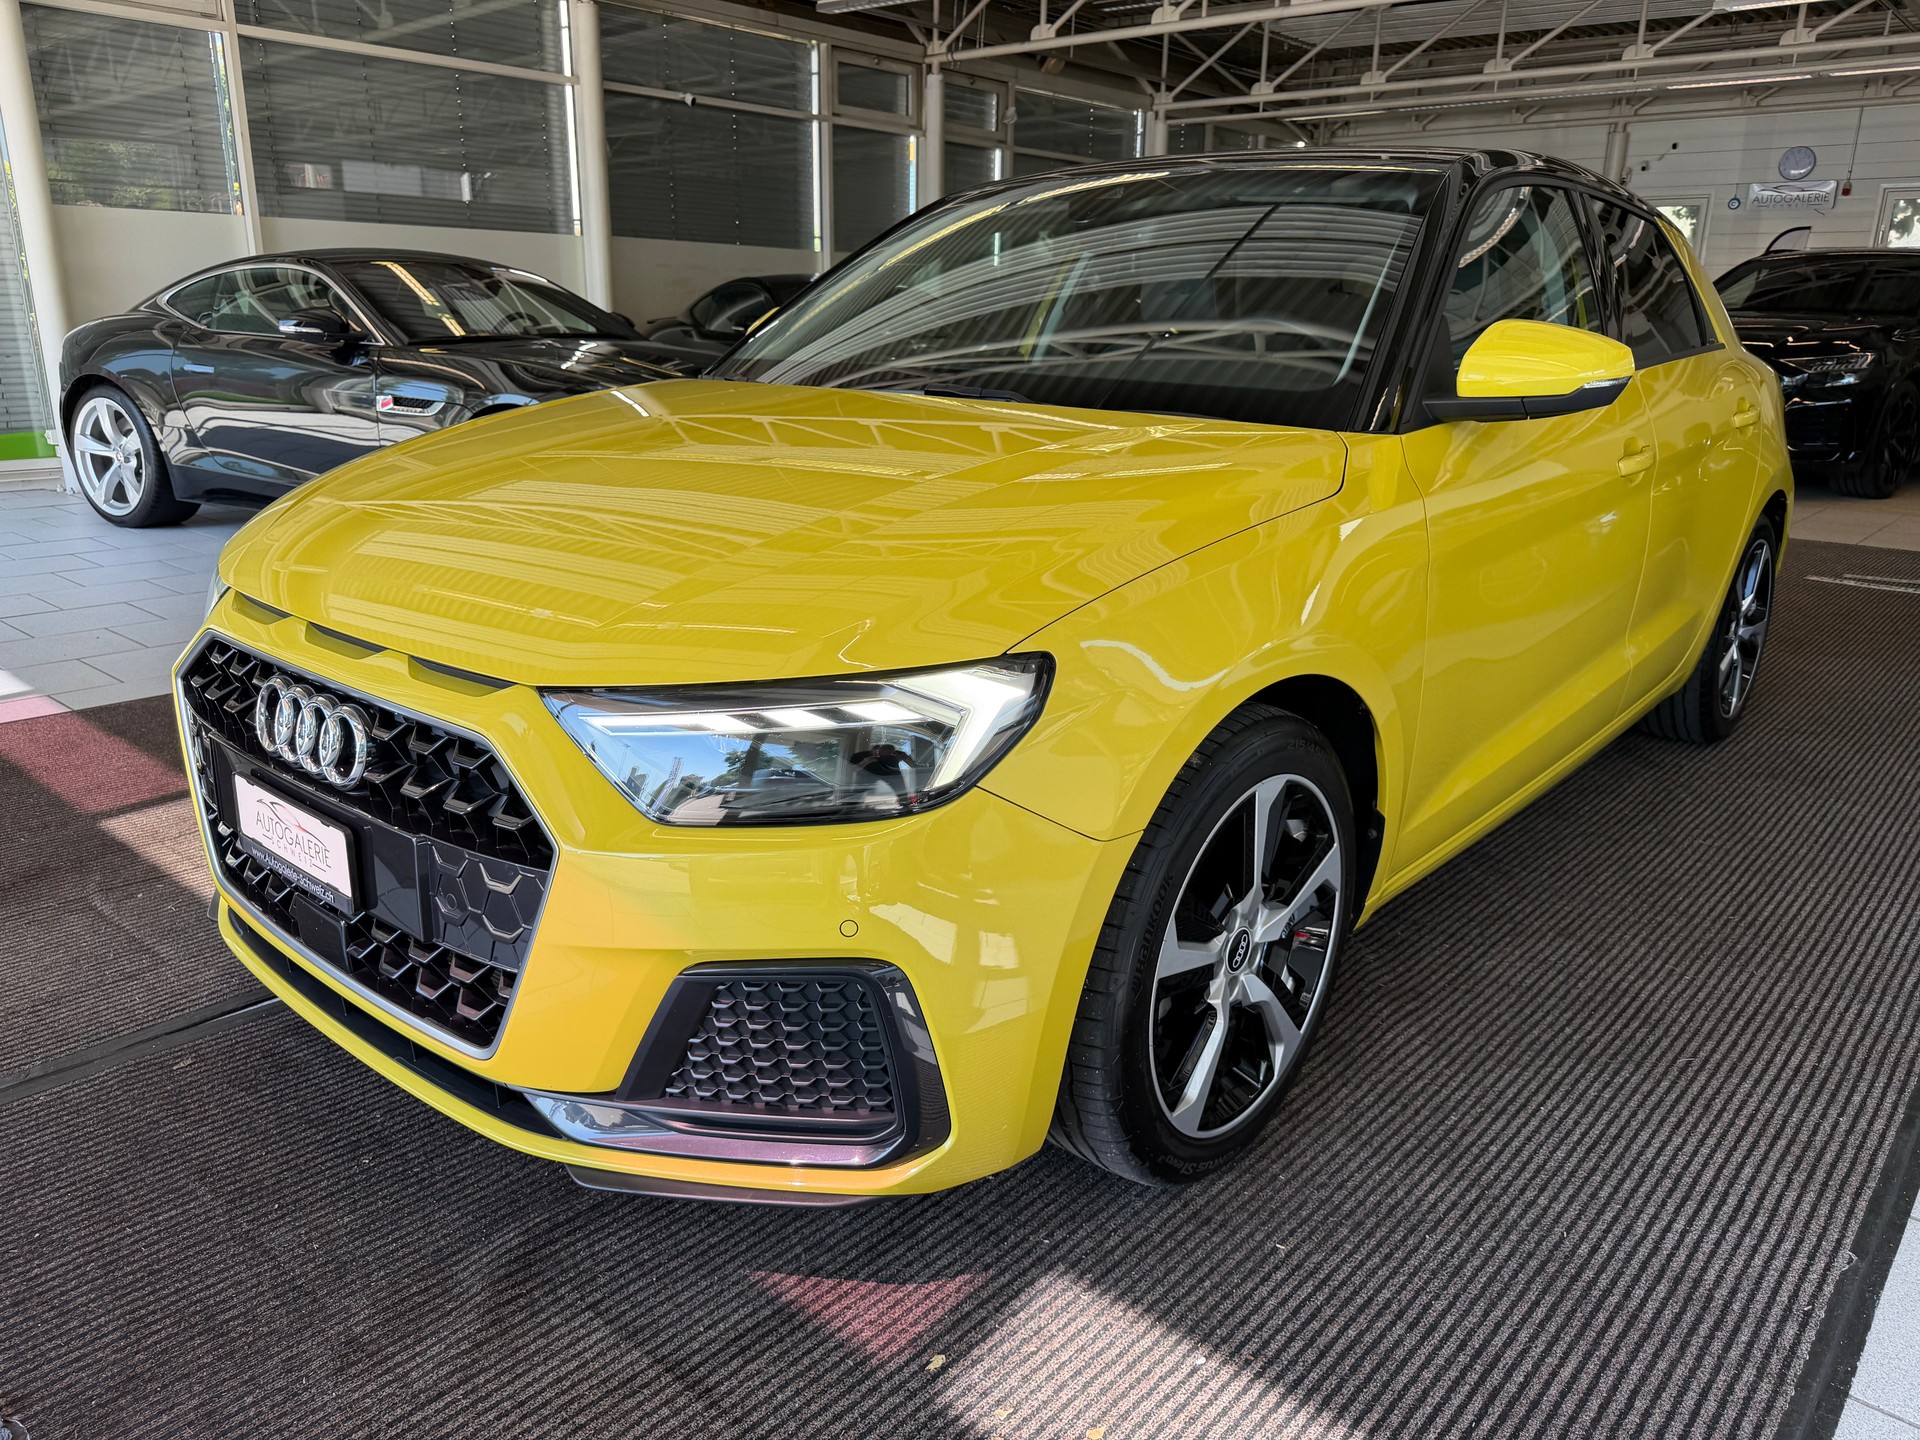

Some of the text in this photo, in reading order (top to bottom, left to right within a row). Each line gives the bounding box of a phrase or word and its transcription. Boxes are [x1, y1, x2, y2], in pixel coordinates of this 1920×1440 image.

[1752, 193, 1830, 204] AUTOGALERIE
[256, 811, 331, 868] AUTOGALERIE
[271, 837, 313, 868] SCHWEIZ
